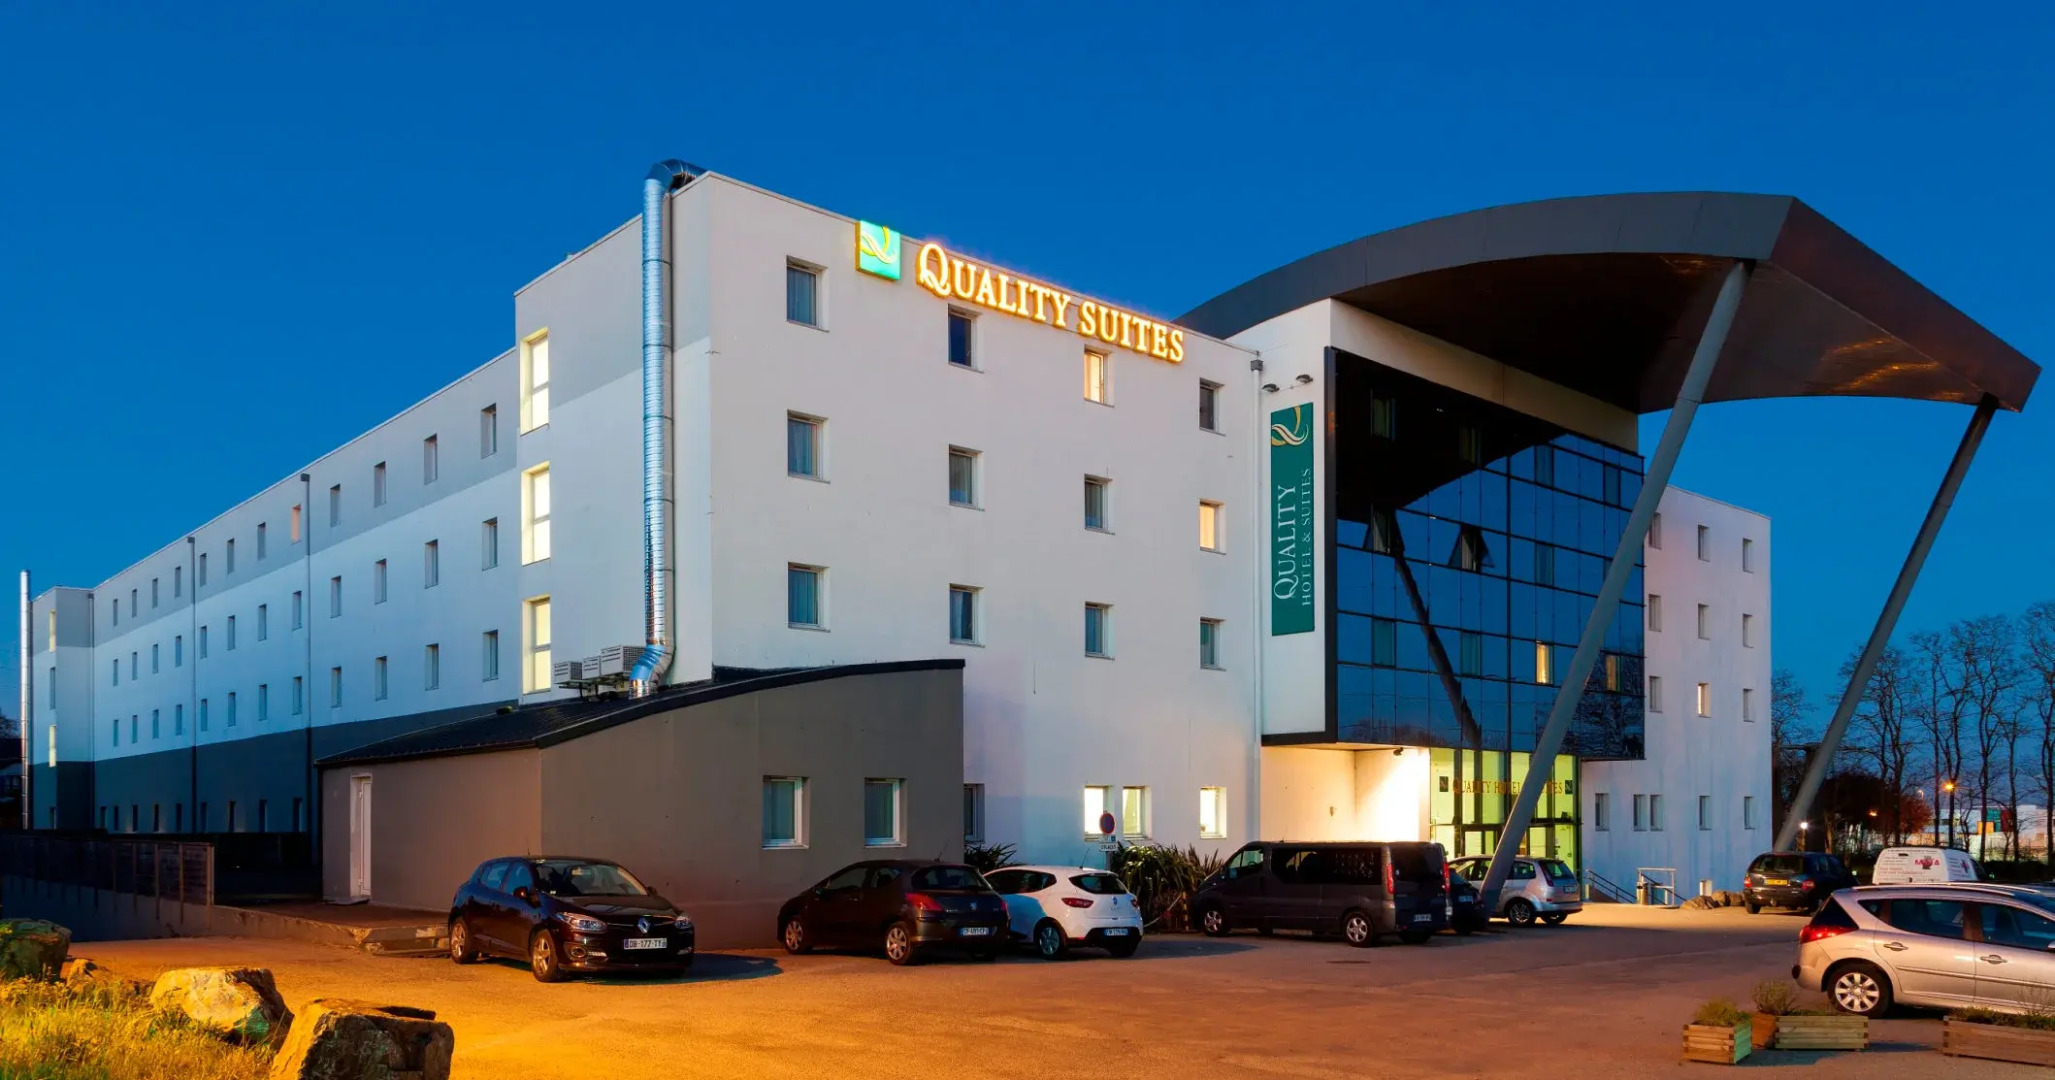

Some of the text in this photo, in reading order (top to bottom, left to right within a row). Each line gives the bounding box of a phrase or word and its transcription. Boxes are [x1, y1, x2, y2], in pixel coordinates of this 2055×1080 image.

[918, 242, 1185, 363] QUALITY SUITES
[1273, 484, 1299, 600] QUALITY
[1302, 468, 1312, 606] HOTEL & SUITES
